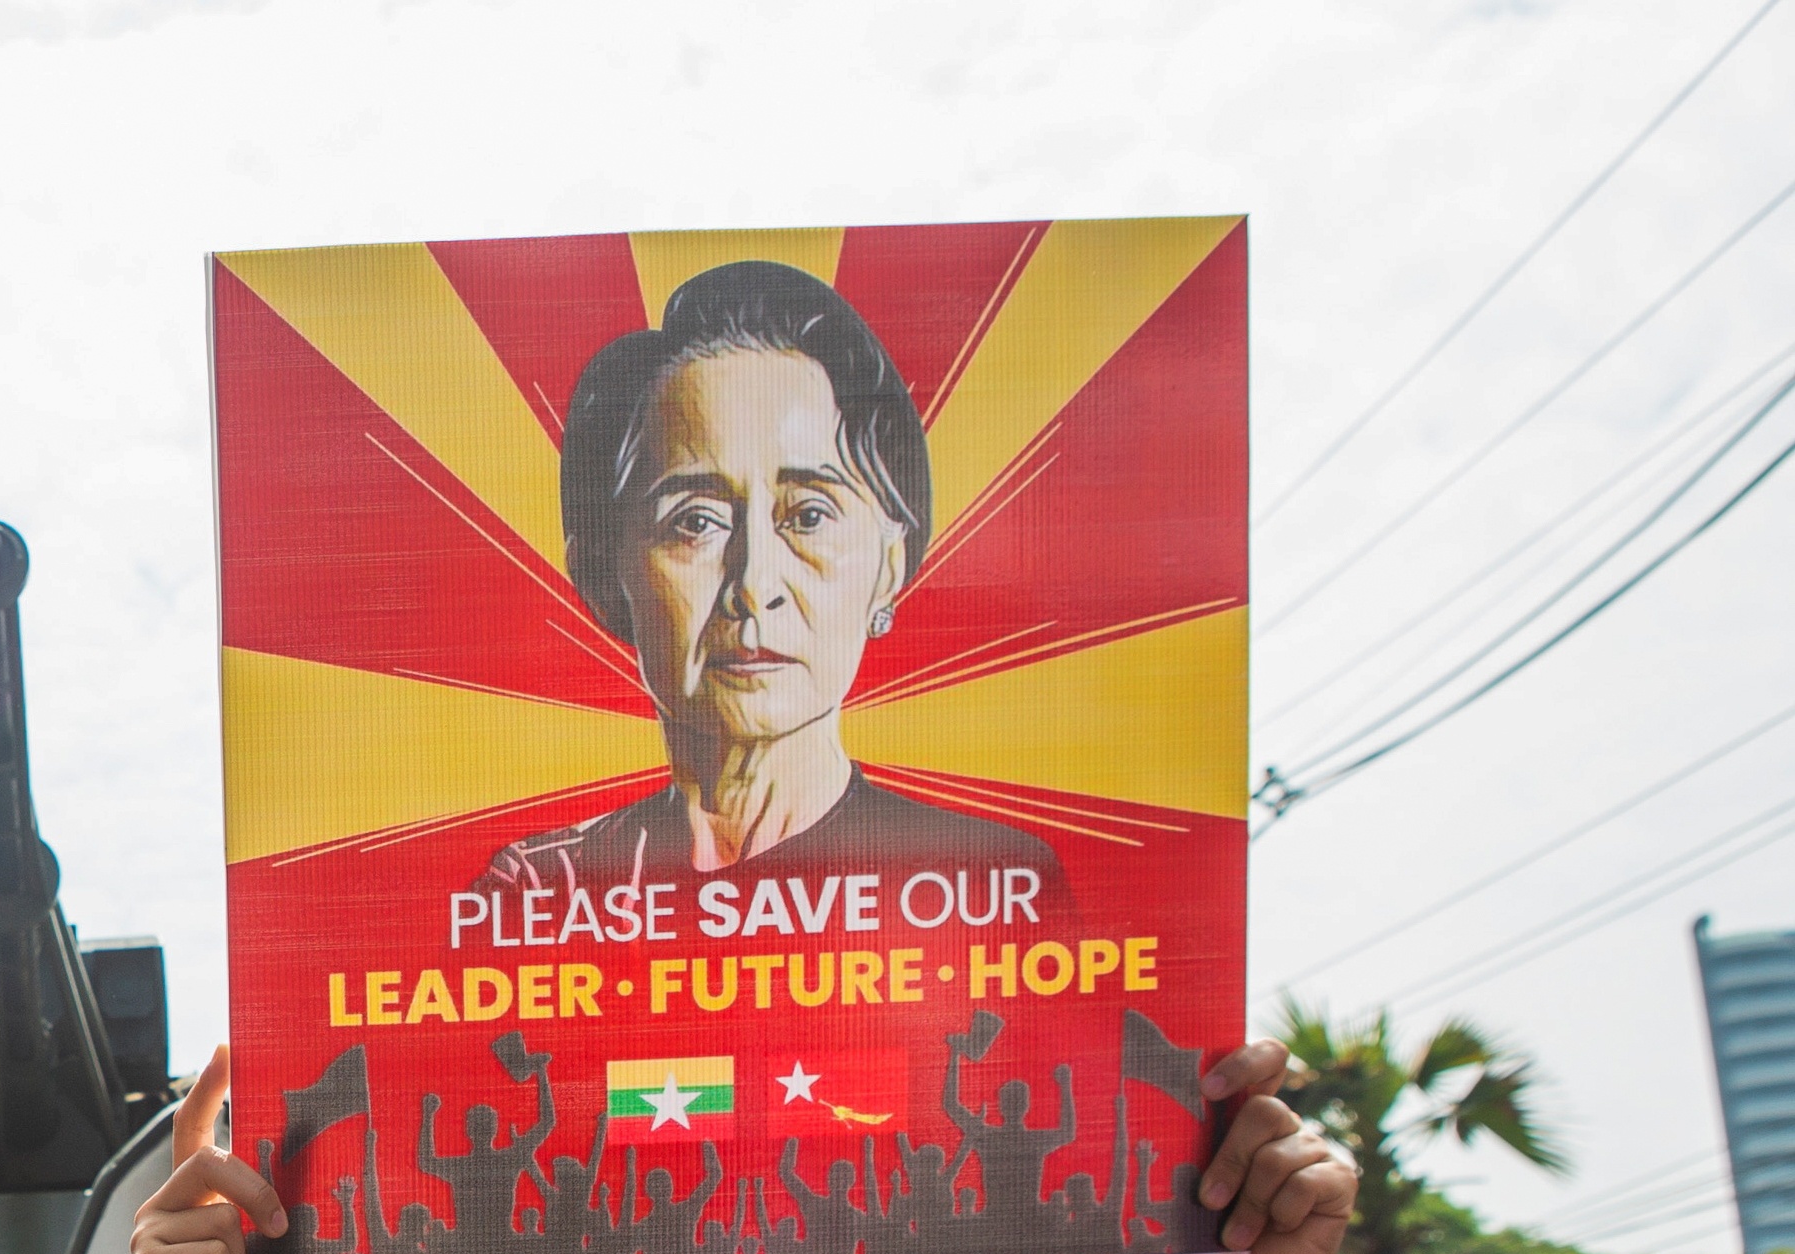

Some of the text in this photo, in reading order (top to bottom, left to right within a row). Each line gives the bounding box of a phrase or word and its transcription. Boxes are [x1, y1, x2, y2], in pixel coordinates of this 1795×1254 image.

[450, 867, 1041, 949] PLEASE SAVE OUR
[328, 937, 1159, 1027] LEADER FUTURE HOPE
